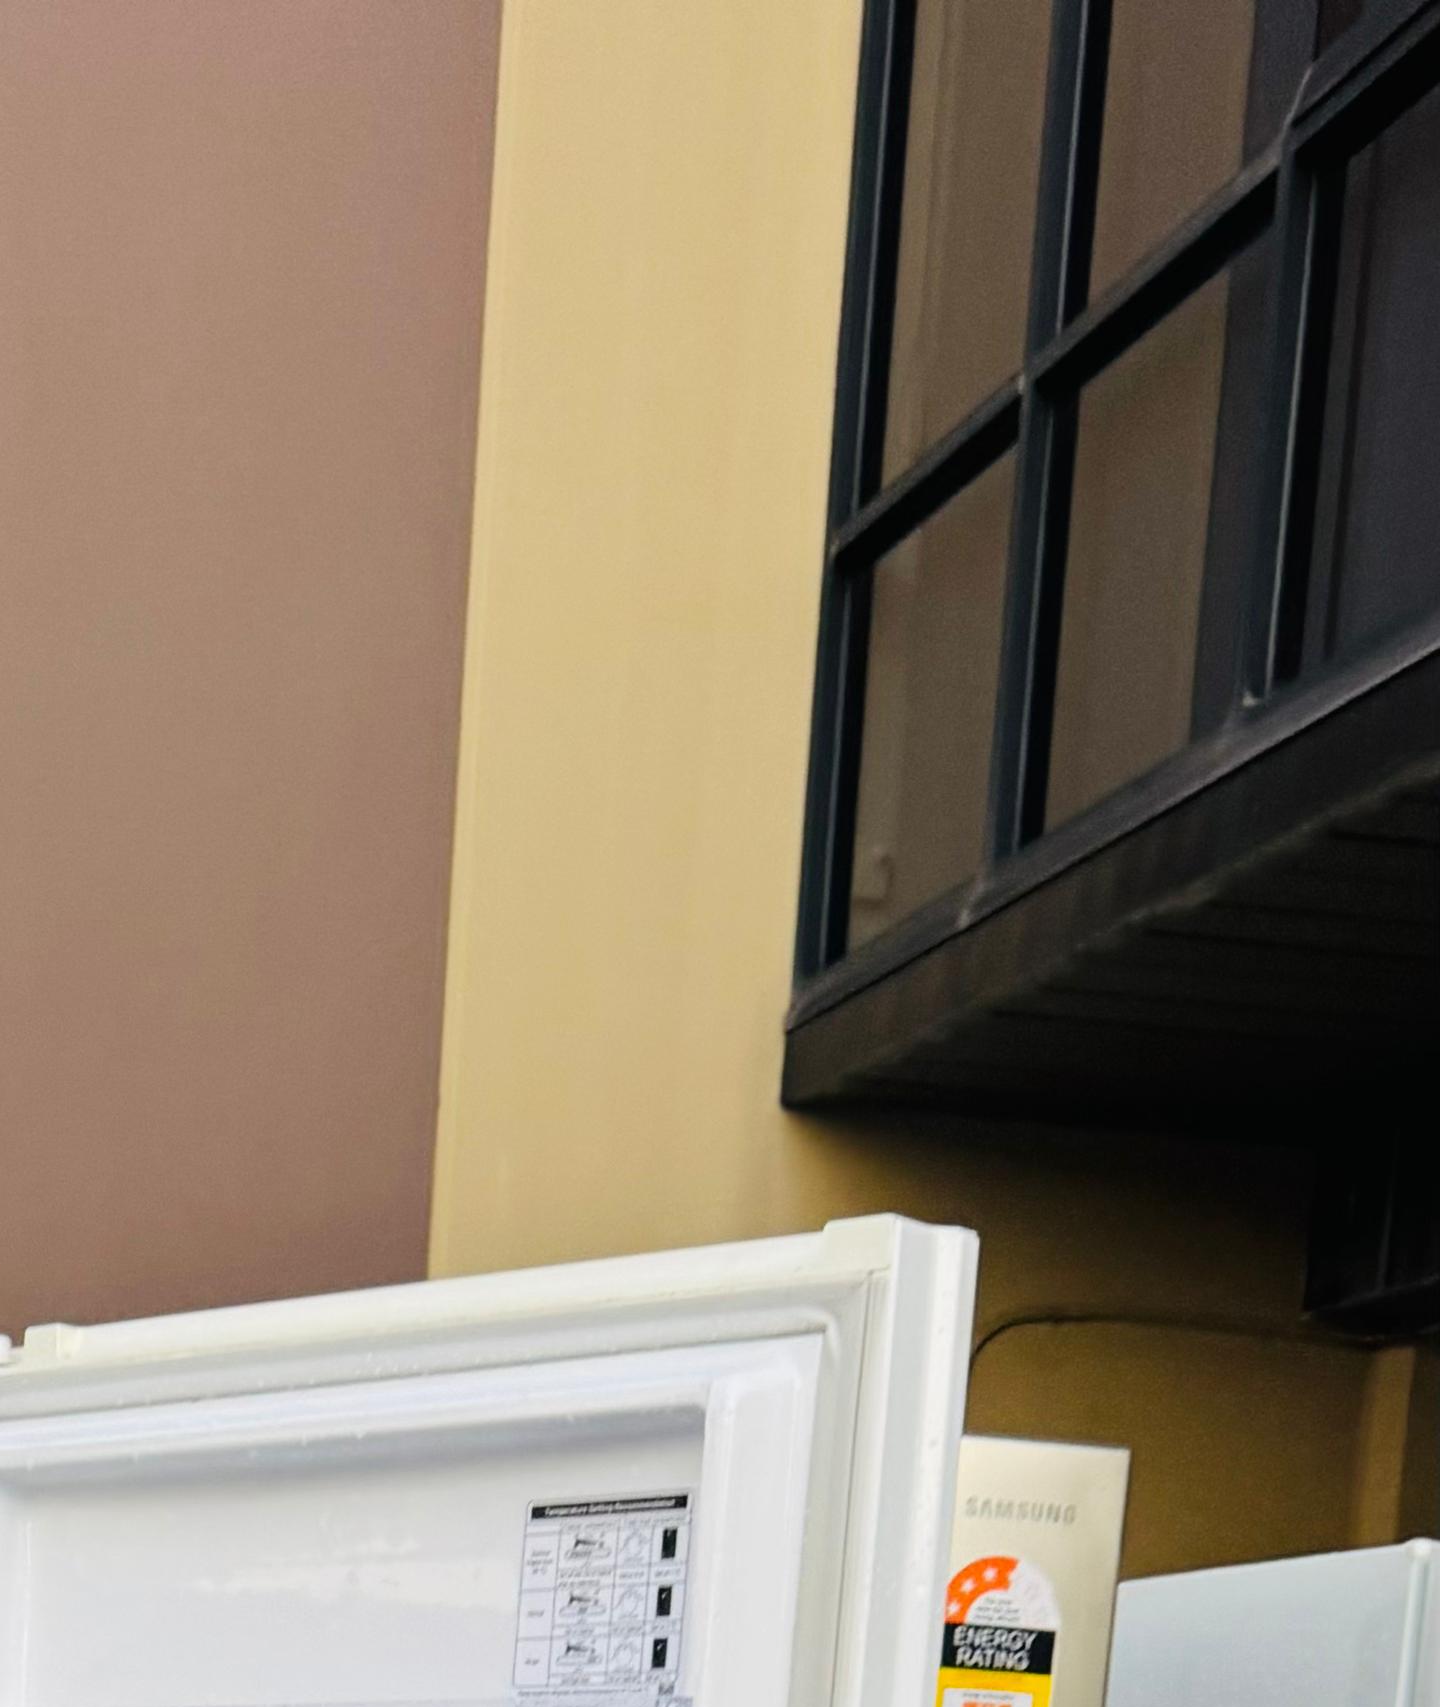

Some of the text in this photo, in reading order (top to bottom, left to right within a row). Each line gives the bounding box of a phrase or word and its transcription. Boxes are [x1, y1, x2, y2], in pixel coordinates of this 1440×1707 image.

[964, 1496, 1077, 1525] SAMSUNG
[953, 1625, 1038, 1651] ENERGY
[955, 1646, 1030, 1671] RATING
